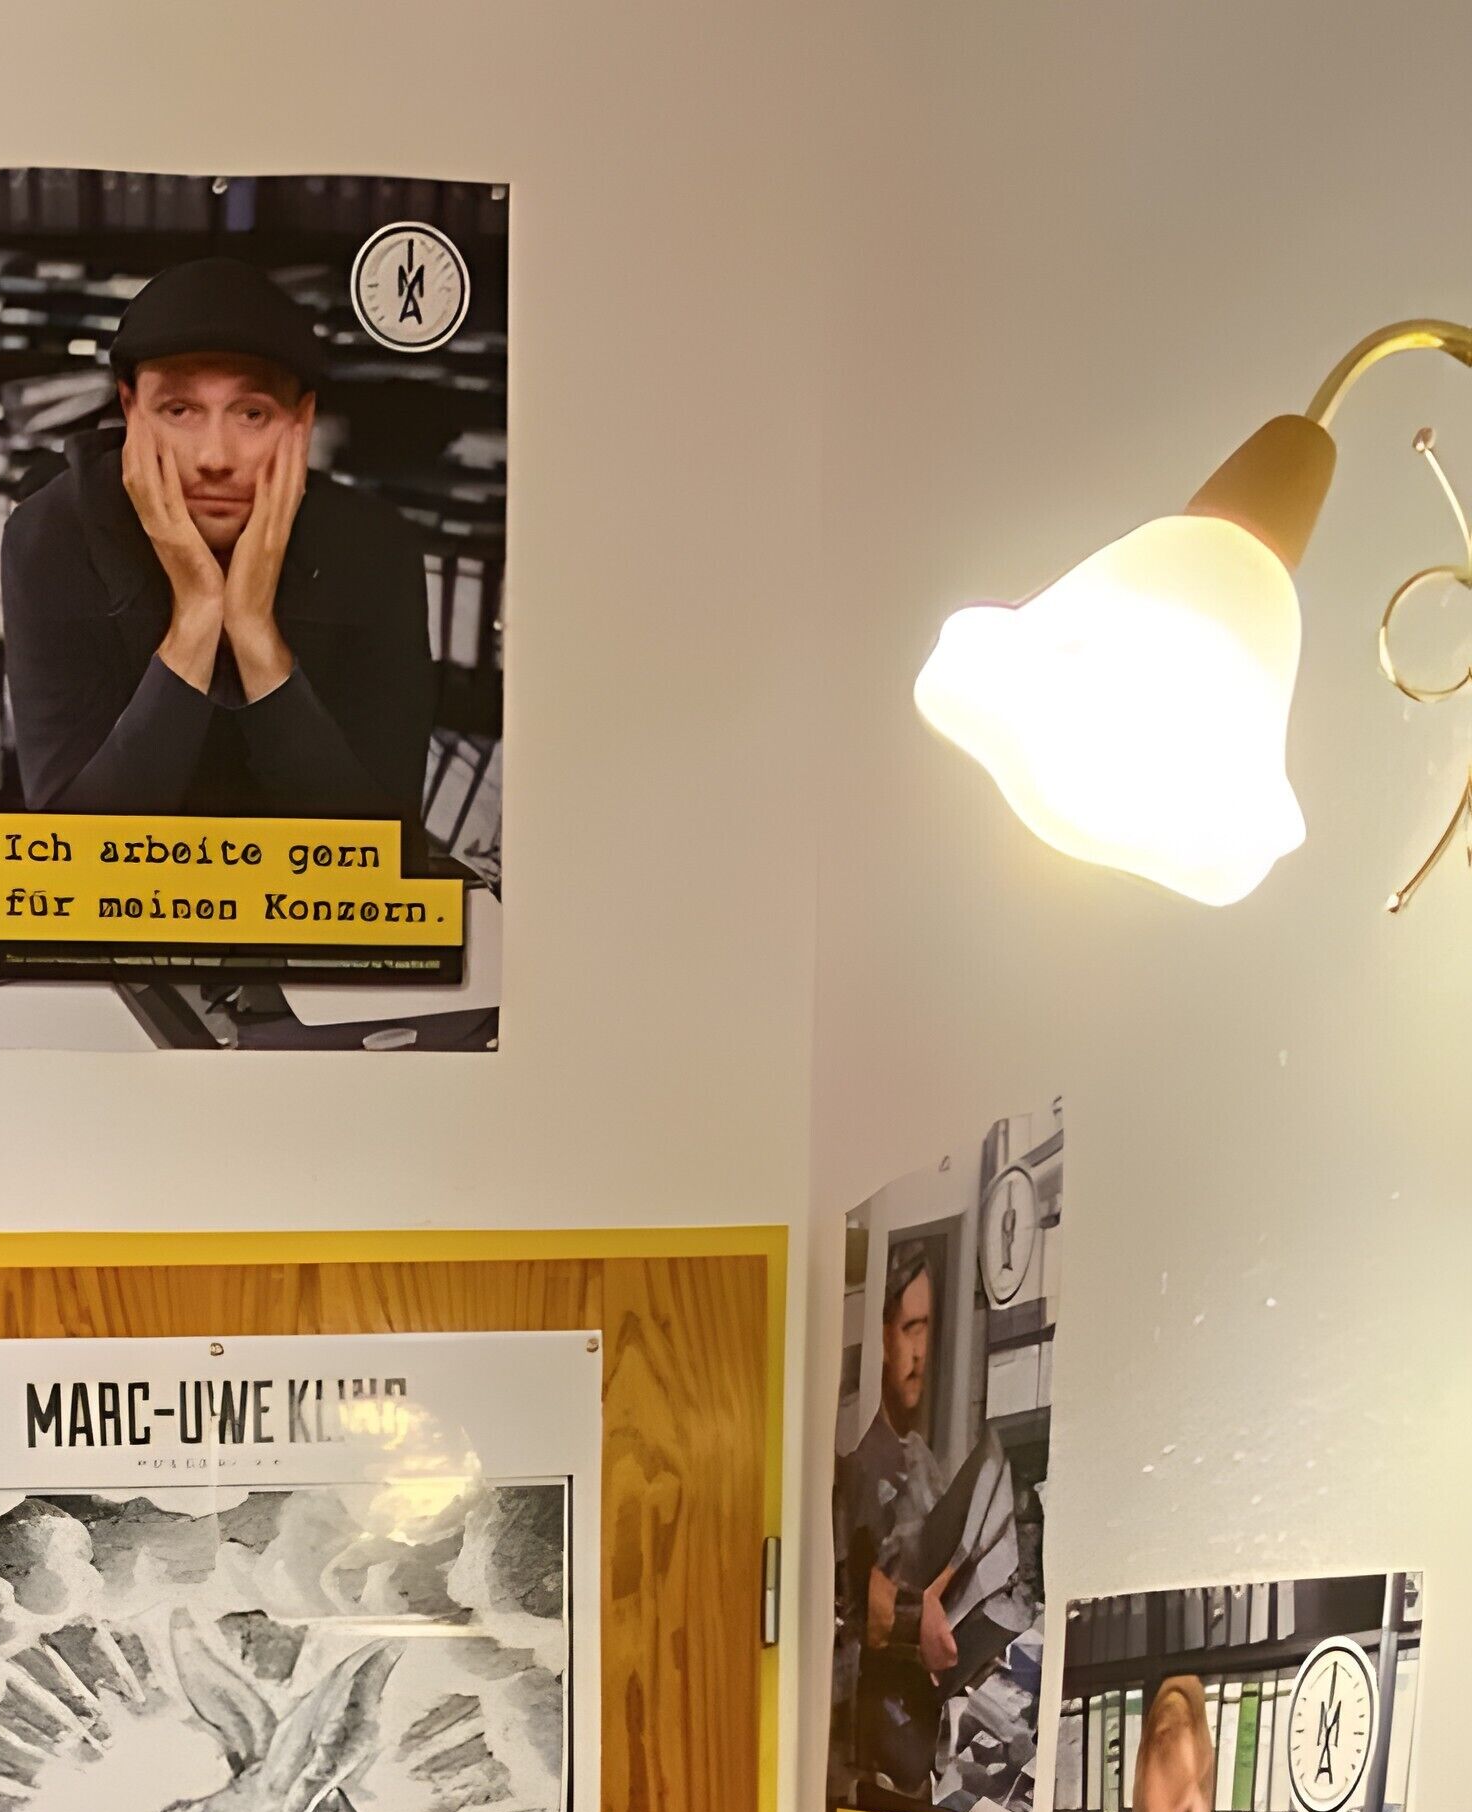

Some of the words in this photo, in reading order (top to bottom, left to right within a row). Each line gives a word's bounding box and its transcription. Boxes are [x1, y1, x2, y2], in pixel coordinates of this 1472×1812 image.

[5, 833, 71, 861] Ich
[6, 888, 74, 916] für
[26, 1375, 278, 1448] MARC-UWE
